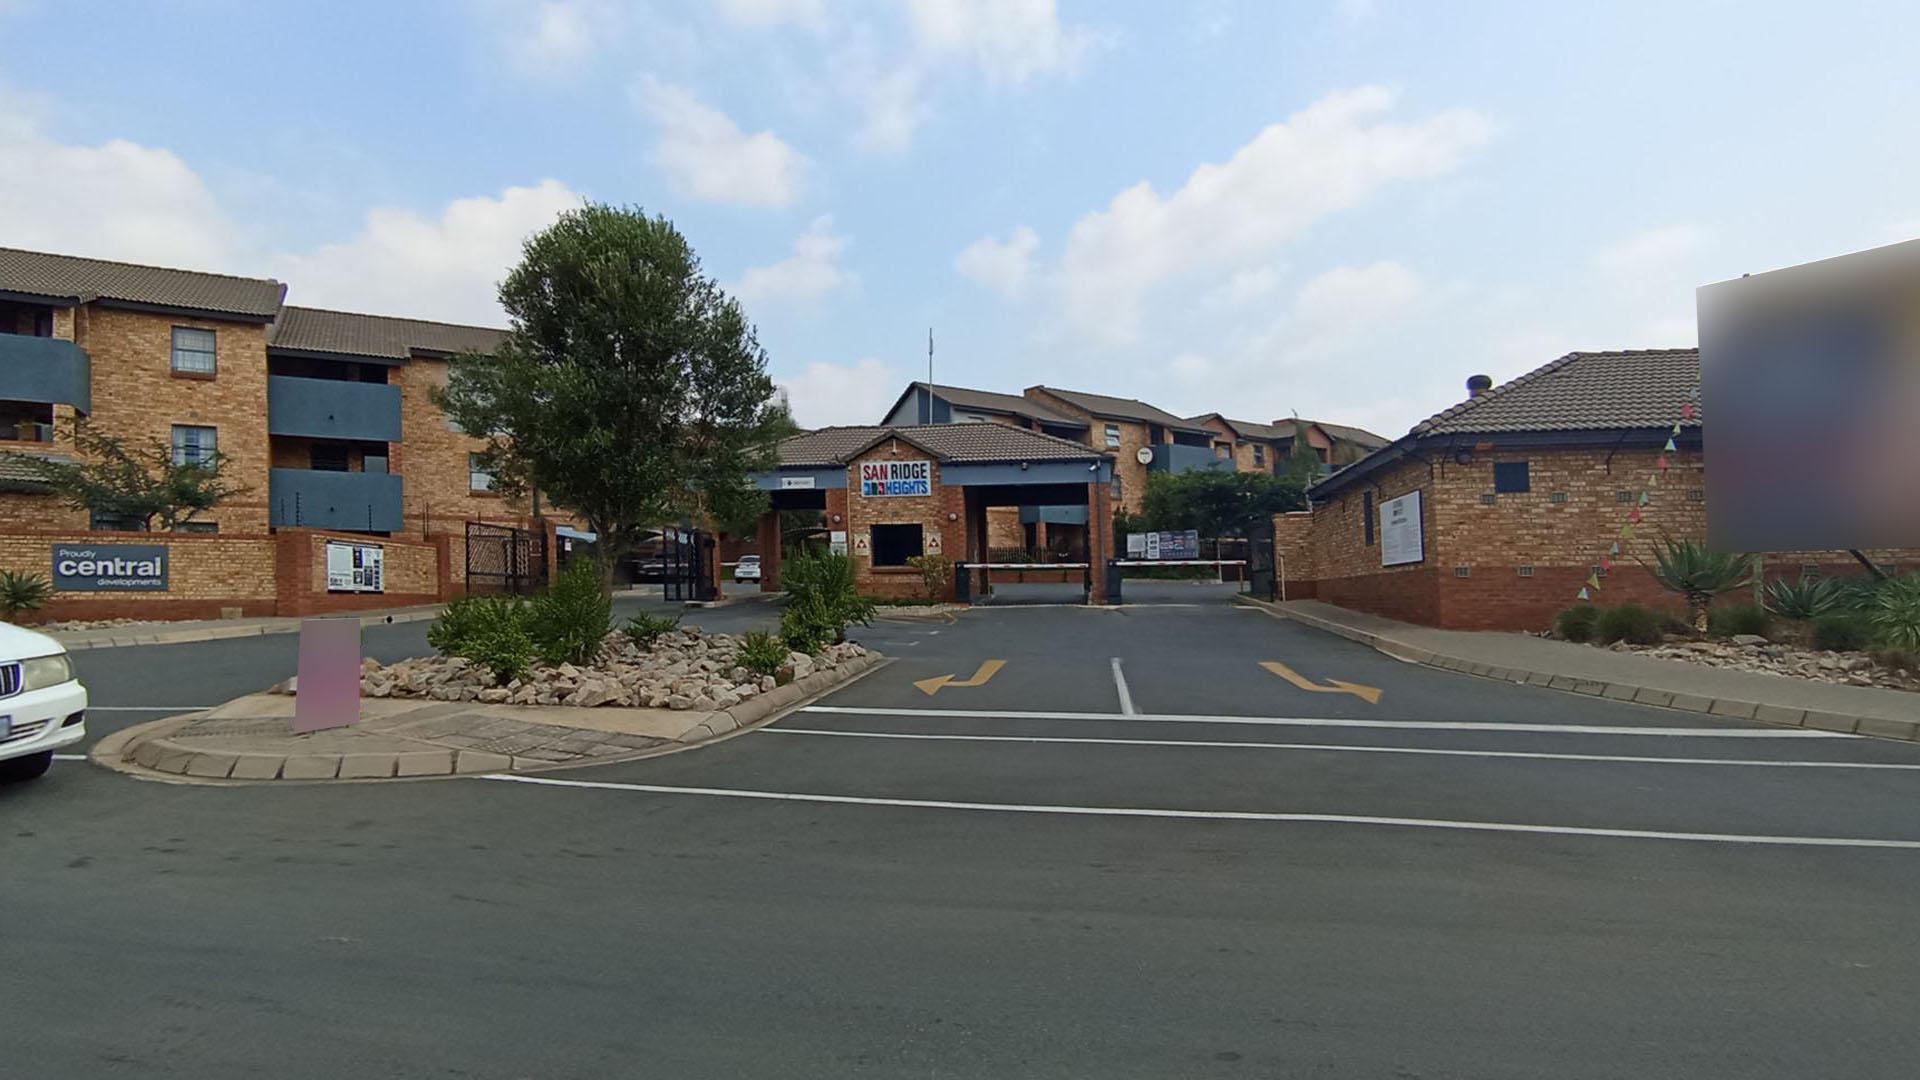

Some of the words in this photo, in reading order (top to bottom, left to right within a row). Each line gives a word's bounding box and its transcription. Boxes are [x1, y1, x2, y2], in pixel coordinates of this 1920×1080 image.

[863, 464, 888, 480] SAN
[891, 463, 927, 480] RIDGE
[886, 480, 928, 495] HEIGHTS
[59, 549, 96, 559] Proudly
[58, 557, 162, 576] central
[97, 578, 162, 586] developments
